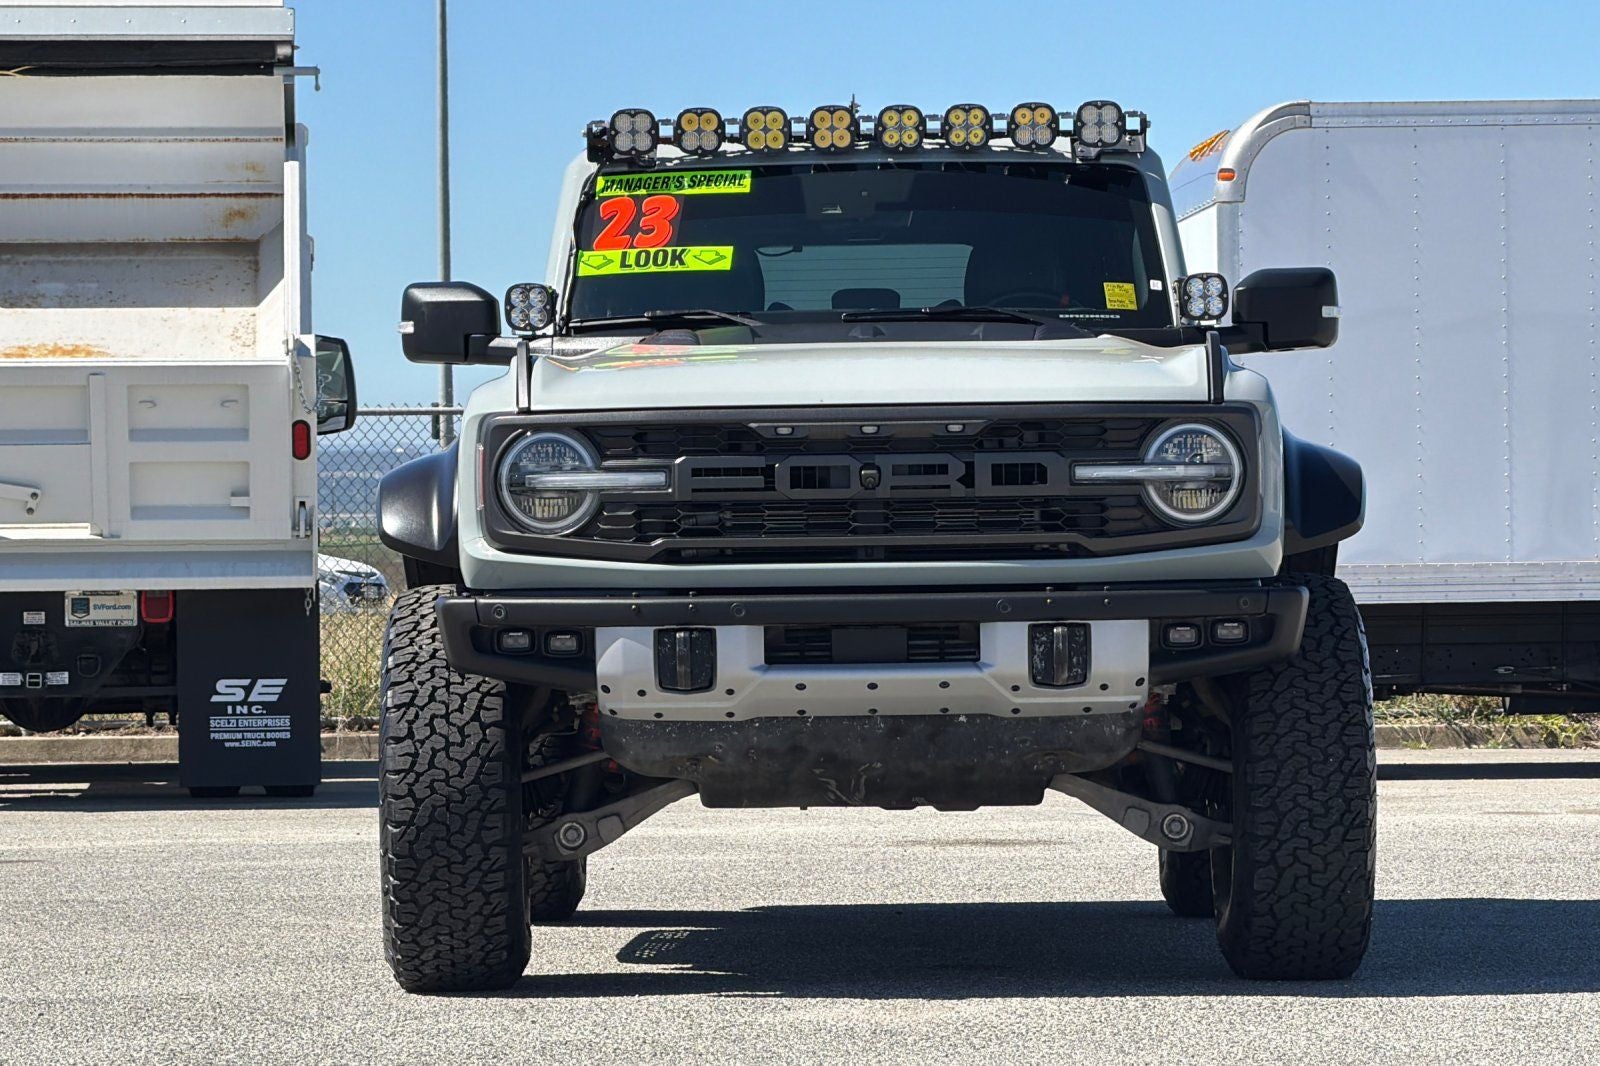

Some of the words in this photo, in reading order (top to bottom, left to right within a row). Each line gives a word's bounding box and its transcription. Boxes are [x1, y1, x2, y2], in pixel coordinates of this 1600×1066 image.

[602, 173, 684, 193] MANAGER'S
[687, 172, 747, 190] SPECIAL
[593, 195, 680, 250] 23
[619, 248, 689, 270] LOOK
[675, 452, 1069, 502] FORD
[93, 603, 131, 611] SVFord.com
[209, 678, 288, 702] SE
[227, 705, 267, 714] INC.
[209, 719, 237, 727] SCELZI
[238, 718, 291, 727] ENTERPRISES
[210, 732, 243, 740] PREMIUM
[266, 731, 291, 739] BODIES
